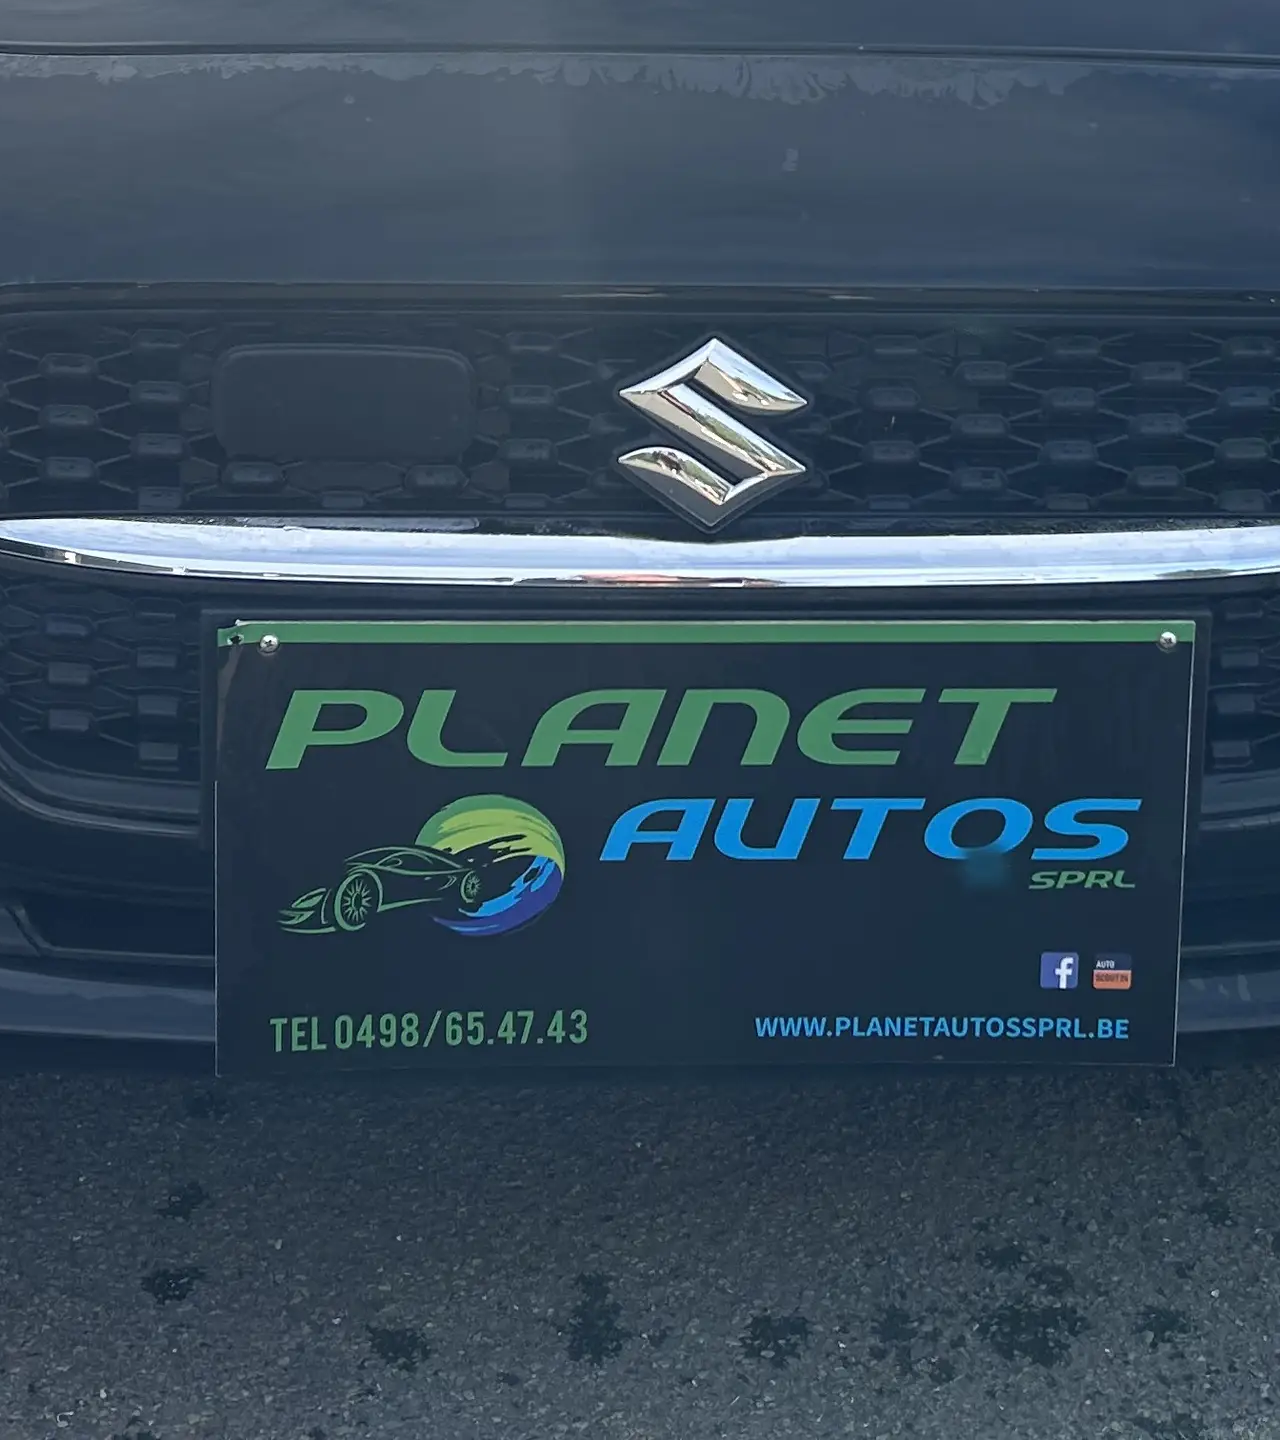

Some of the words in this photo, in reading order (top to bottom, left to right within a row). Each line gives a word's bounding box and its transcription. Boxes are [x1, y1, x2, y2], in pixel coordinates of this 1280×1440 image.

[265, 688, 1058, 770] PLANET
[599, 797, 1142, 862] AUTOS
[1028, 869, 1136, 891] SPRL
[269, 1016, 327, 1053] TEL
[334, 1009, 588, 1050] 0498/65.47.43
[755, 1016, 1130, 1040] WWW.PLANETAUTOSSPRL.BE
